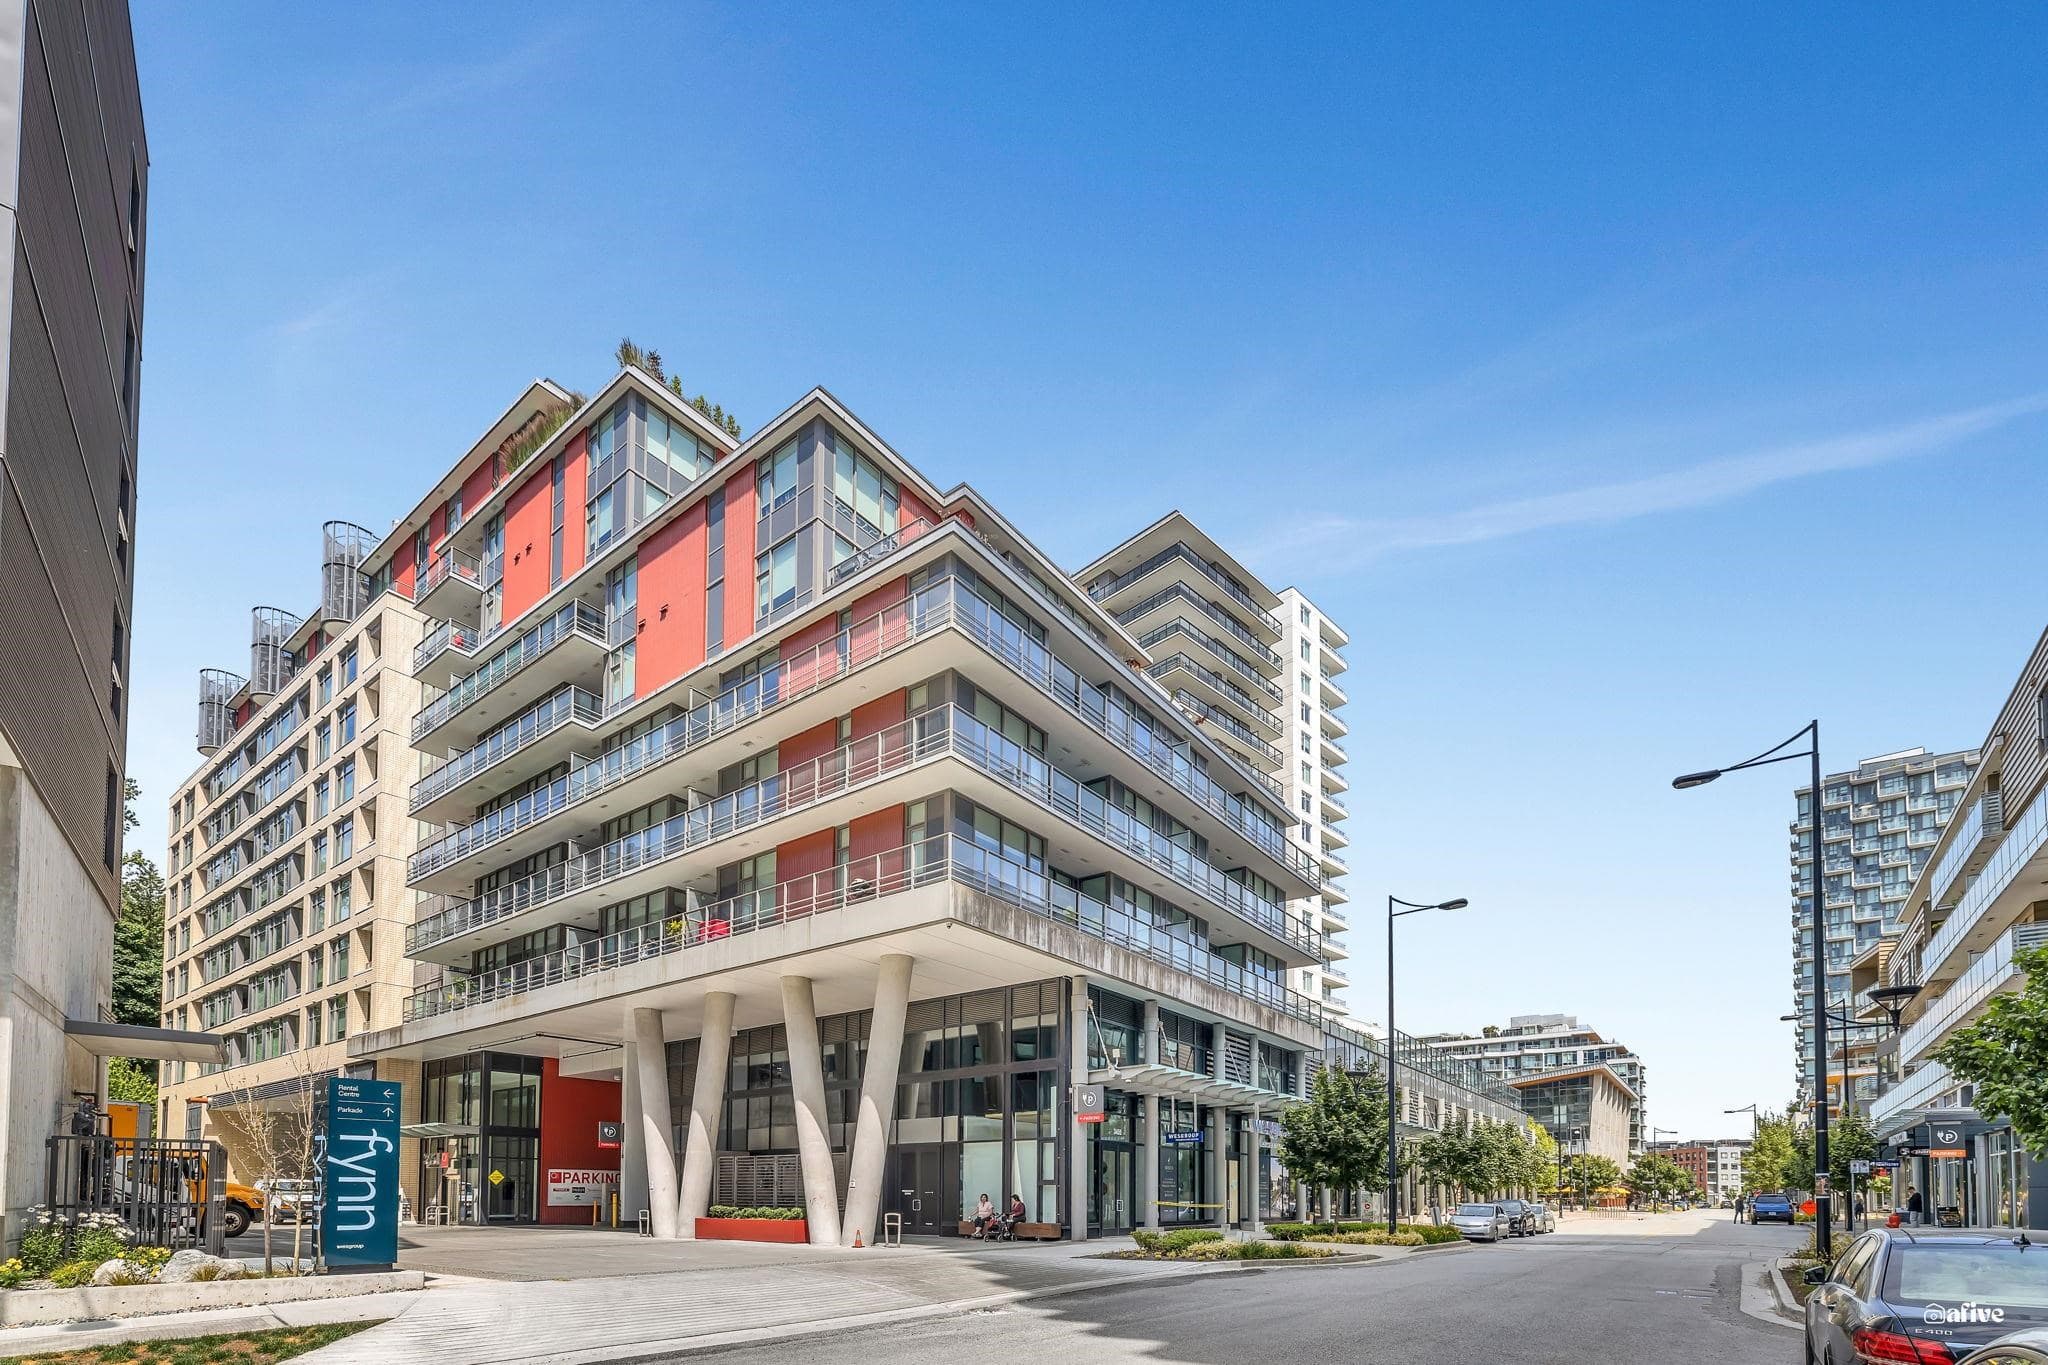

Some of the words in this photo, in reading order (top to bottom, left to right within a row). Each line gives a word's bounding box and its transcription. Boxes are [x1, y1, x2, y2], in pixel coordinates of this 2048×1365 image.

[338, 1084, 359, 1092] Rental
[338, 1090, 360, 1098] Centre
[337, 1106, 363, 1114] Parkade
[328, 1128, 394, 1231] fynn
